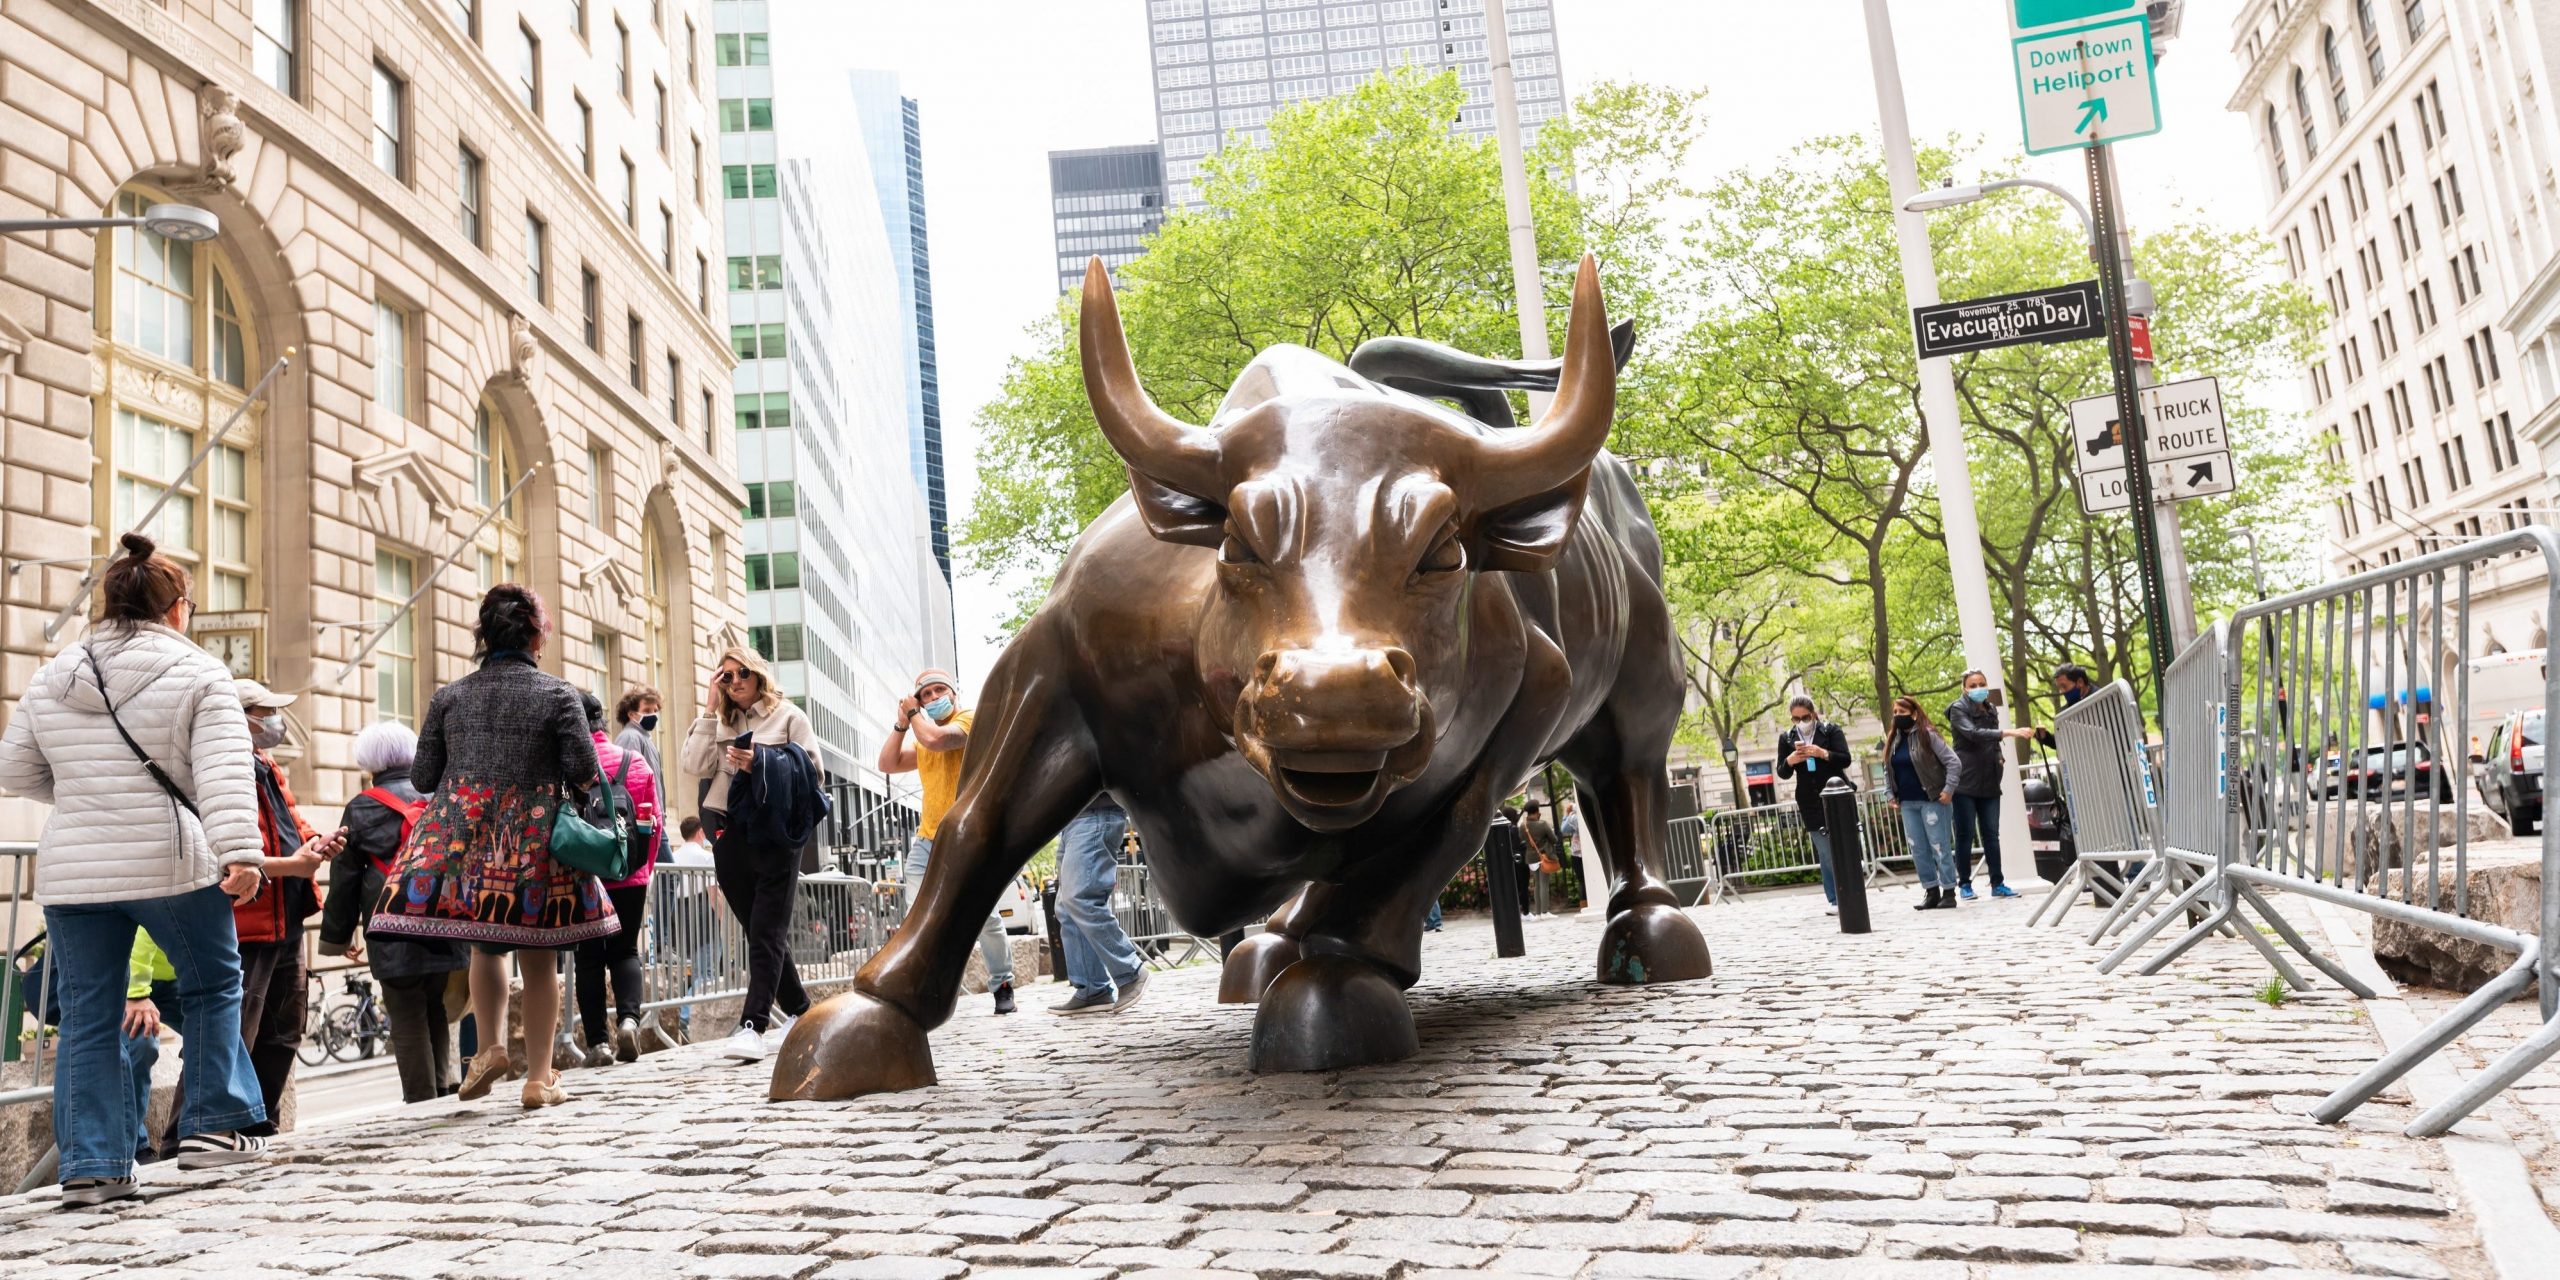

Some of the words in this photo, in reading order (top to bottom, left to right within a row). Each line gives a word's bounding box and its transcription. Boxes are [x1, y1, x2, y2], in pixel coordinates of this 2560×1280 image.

[2030, 38, 2132, 67] Downtown
[2033, 61, 2135, 94] Heliport
[1926, 309, 2039, 341] Evacuation
[2042, 303, 2082, 325] Day
[1959, 305, 2000, 318] November
[2026, 297, 2046, 308] 1783
[1992, 328, 2021, 340] PLAZA
[2153, 398, 2212, 422] TRUCK
[2158, 427, 2218, 451] ROUTE
[2229, 683, 2240, 737] FRIEDRICHS
[2136, 742, 2156, 804] NYPD
